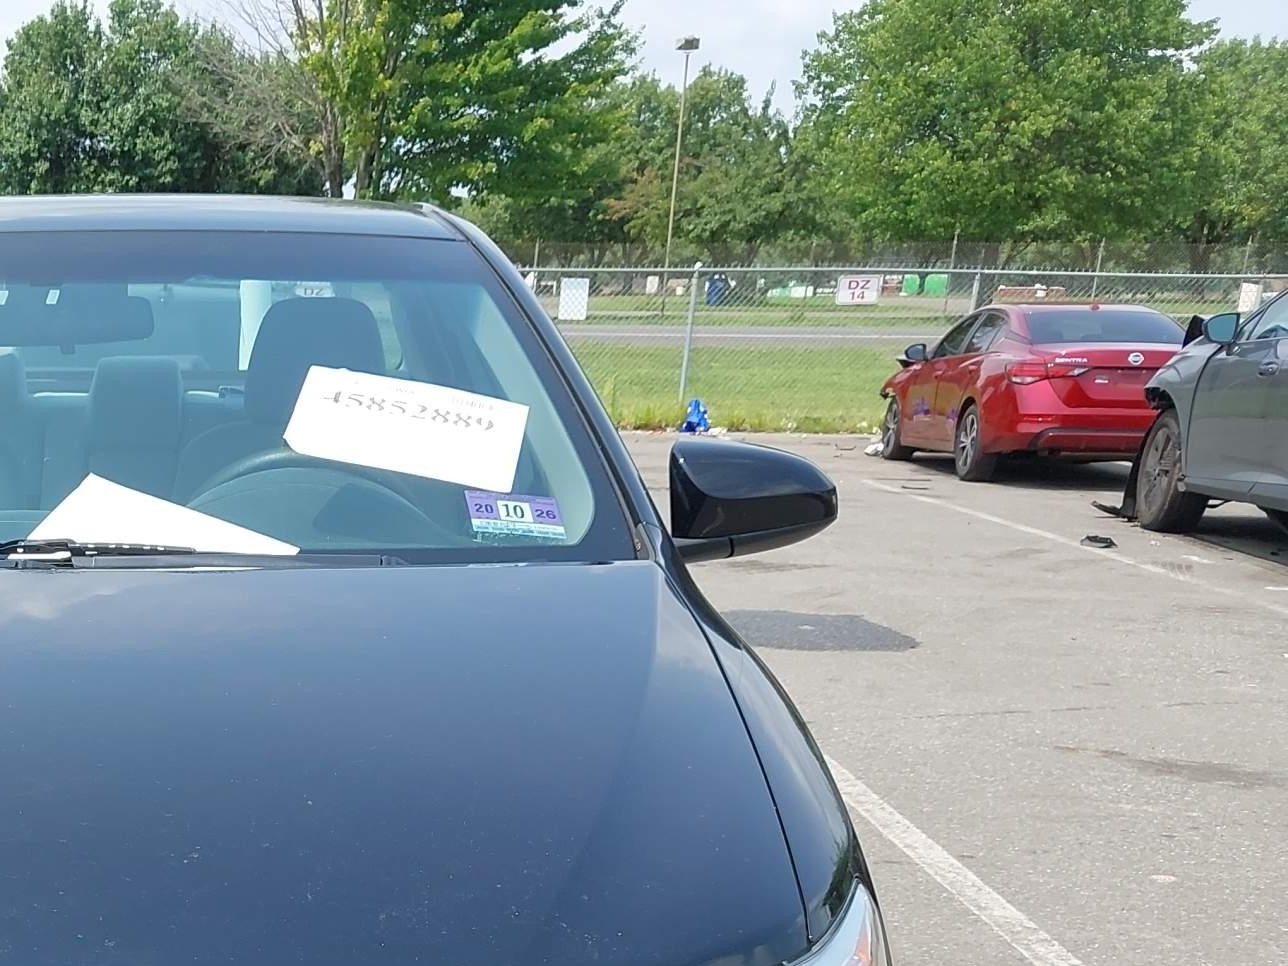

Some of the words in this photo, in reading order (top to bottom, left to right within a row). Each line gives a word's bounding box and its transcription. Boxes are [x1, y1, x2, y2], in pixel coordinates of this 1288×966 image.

[848, 279, 872, 290] DZ
[849, 290, 865, 301] 14
[474, 503, 494, 514] 20
[501, 503, 525, 520] 10
[534, 508, 557, 520] 26
